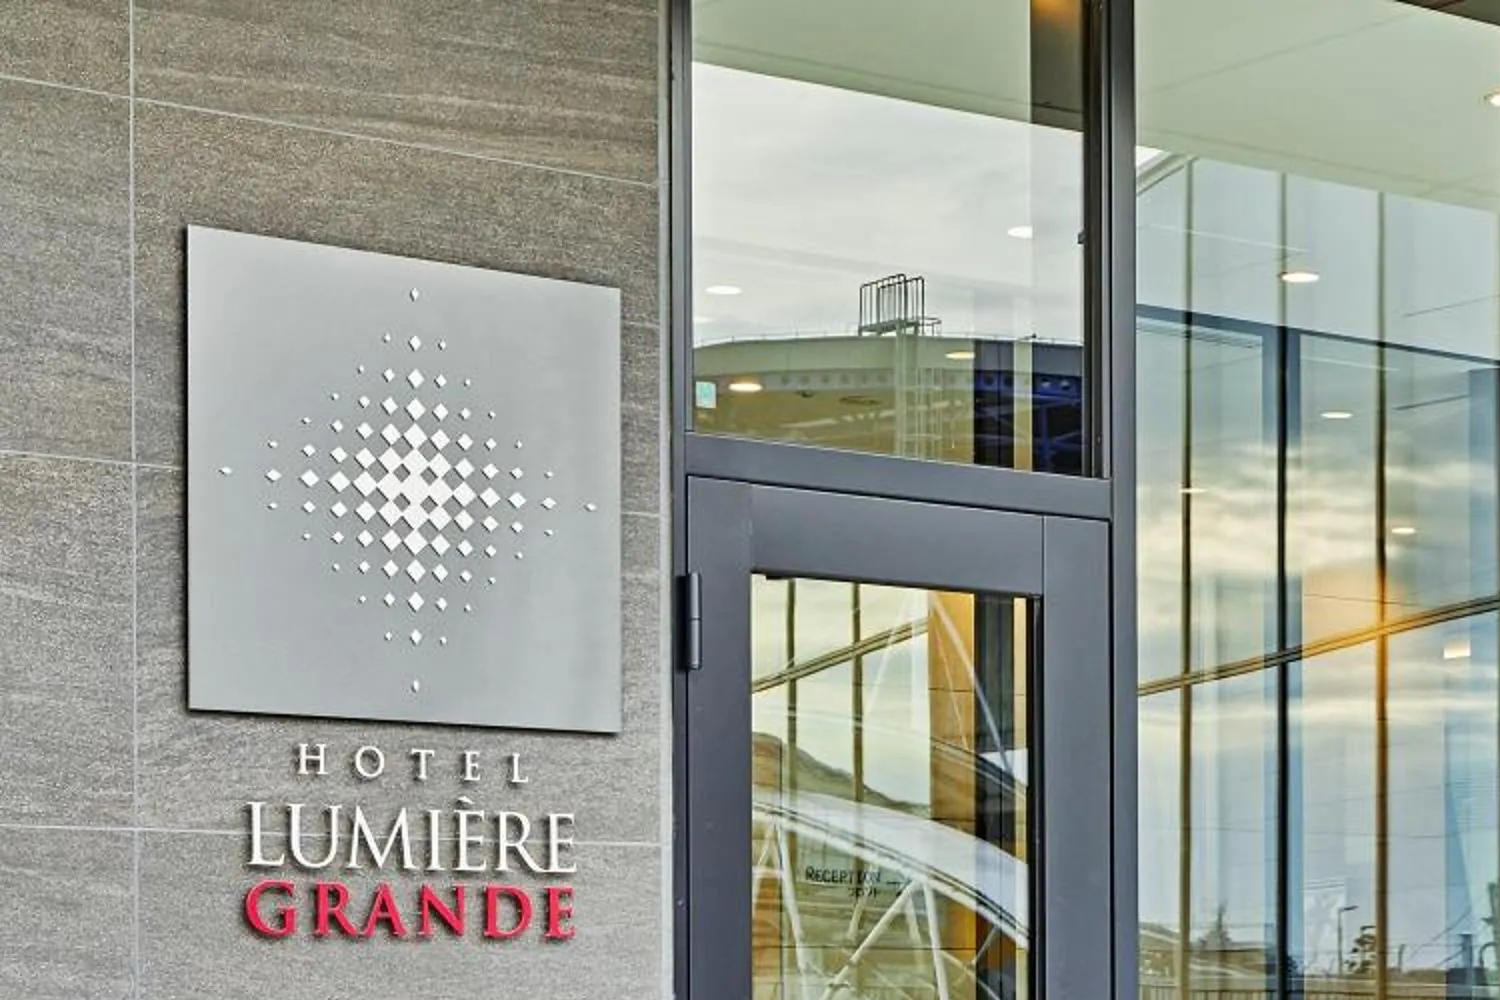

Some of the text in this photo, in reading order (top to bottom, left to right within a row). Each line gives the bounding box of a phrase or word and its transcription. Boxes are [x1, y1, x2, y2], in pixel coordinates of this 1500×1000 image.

[297, 743, 530, 784] HOTEL
[246, 795, 577, 873] LUMIÈRE
[804, 865, 881, 885] RECEPTION
[244, 879, 577, 941] GRANDE
